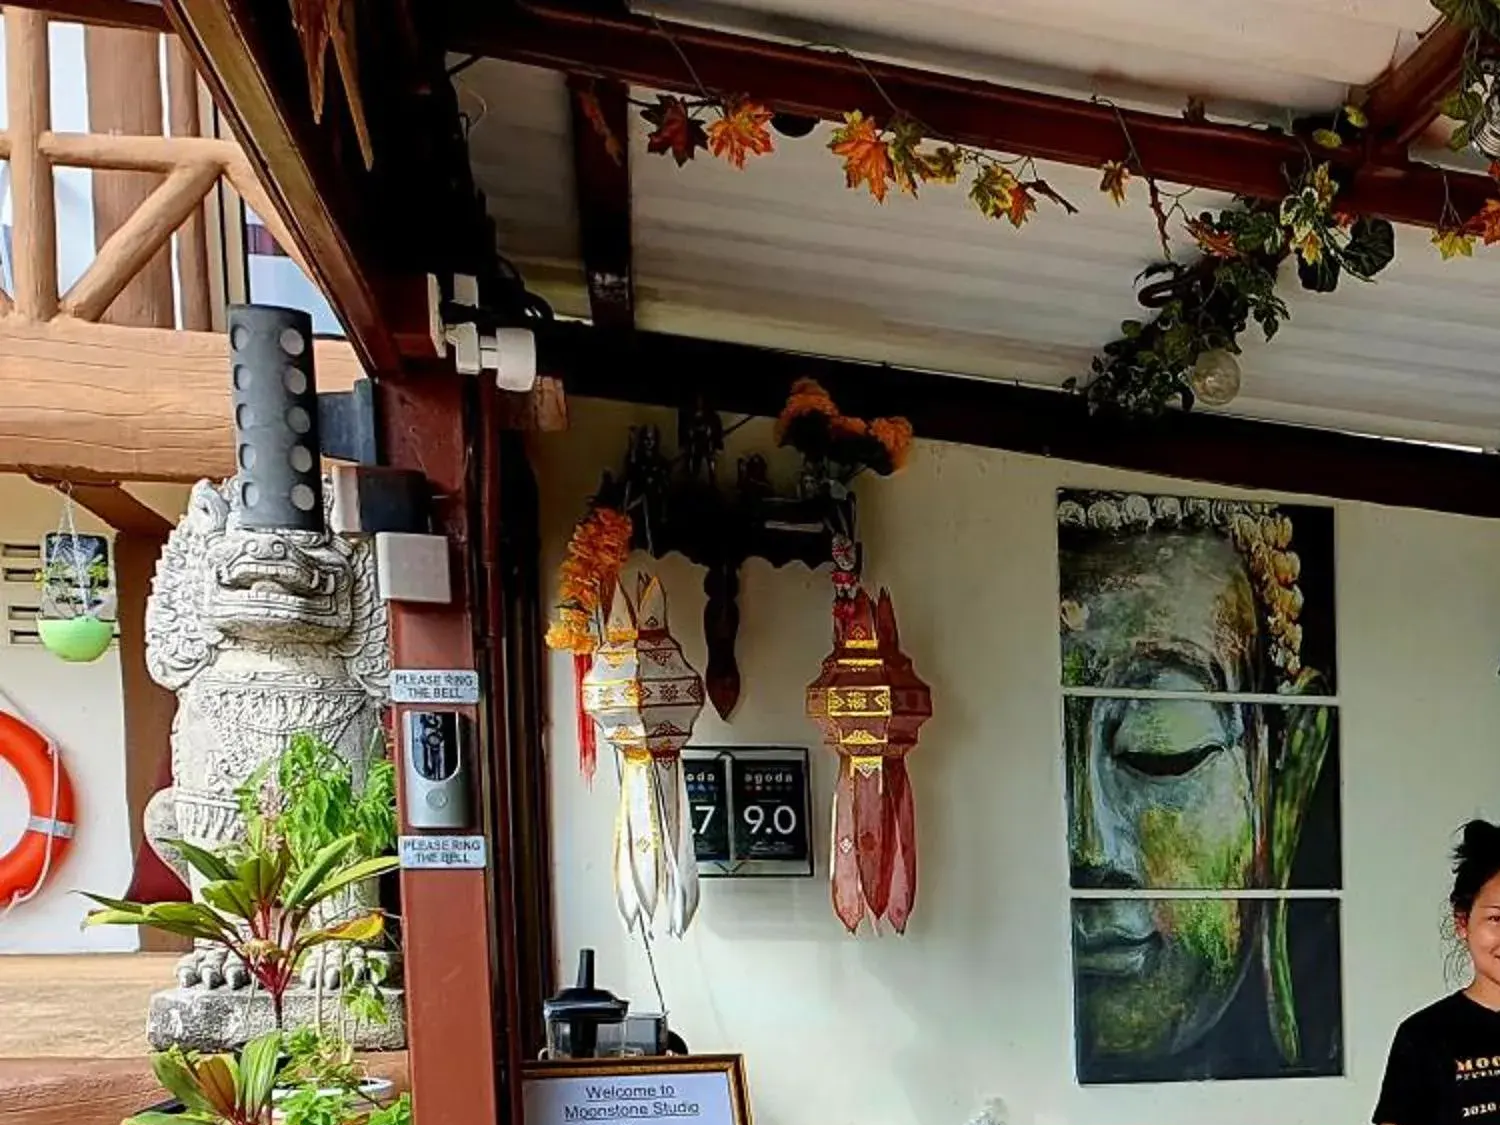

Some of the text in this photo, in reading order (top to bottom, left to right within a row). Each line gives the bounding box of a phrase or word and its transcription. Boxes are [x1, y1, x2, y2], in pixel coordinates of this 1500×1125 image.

[395, 674, 441, 686] PLEASE
[408, 687, 464, 698] THE BELL
[744, 771, 793, 784] agoda
[743, 805, 796, 834] 9.0
[403, 839, 480, 851] PLEASE RING
[415, 852, 470, 864] THE BELL
[586, 1083, 675, 1100] Welcome to
[565, 1101, 700, 1119] Moonstone Studio
